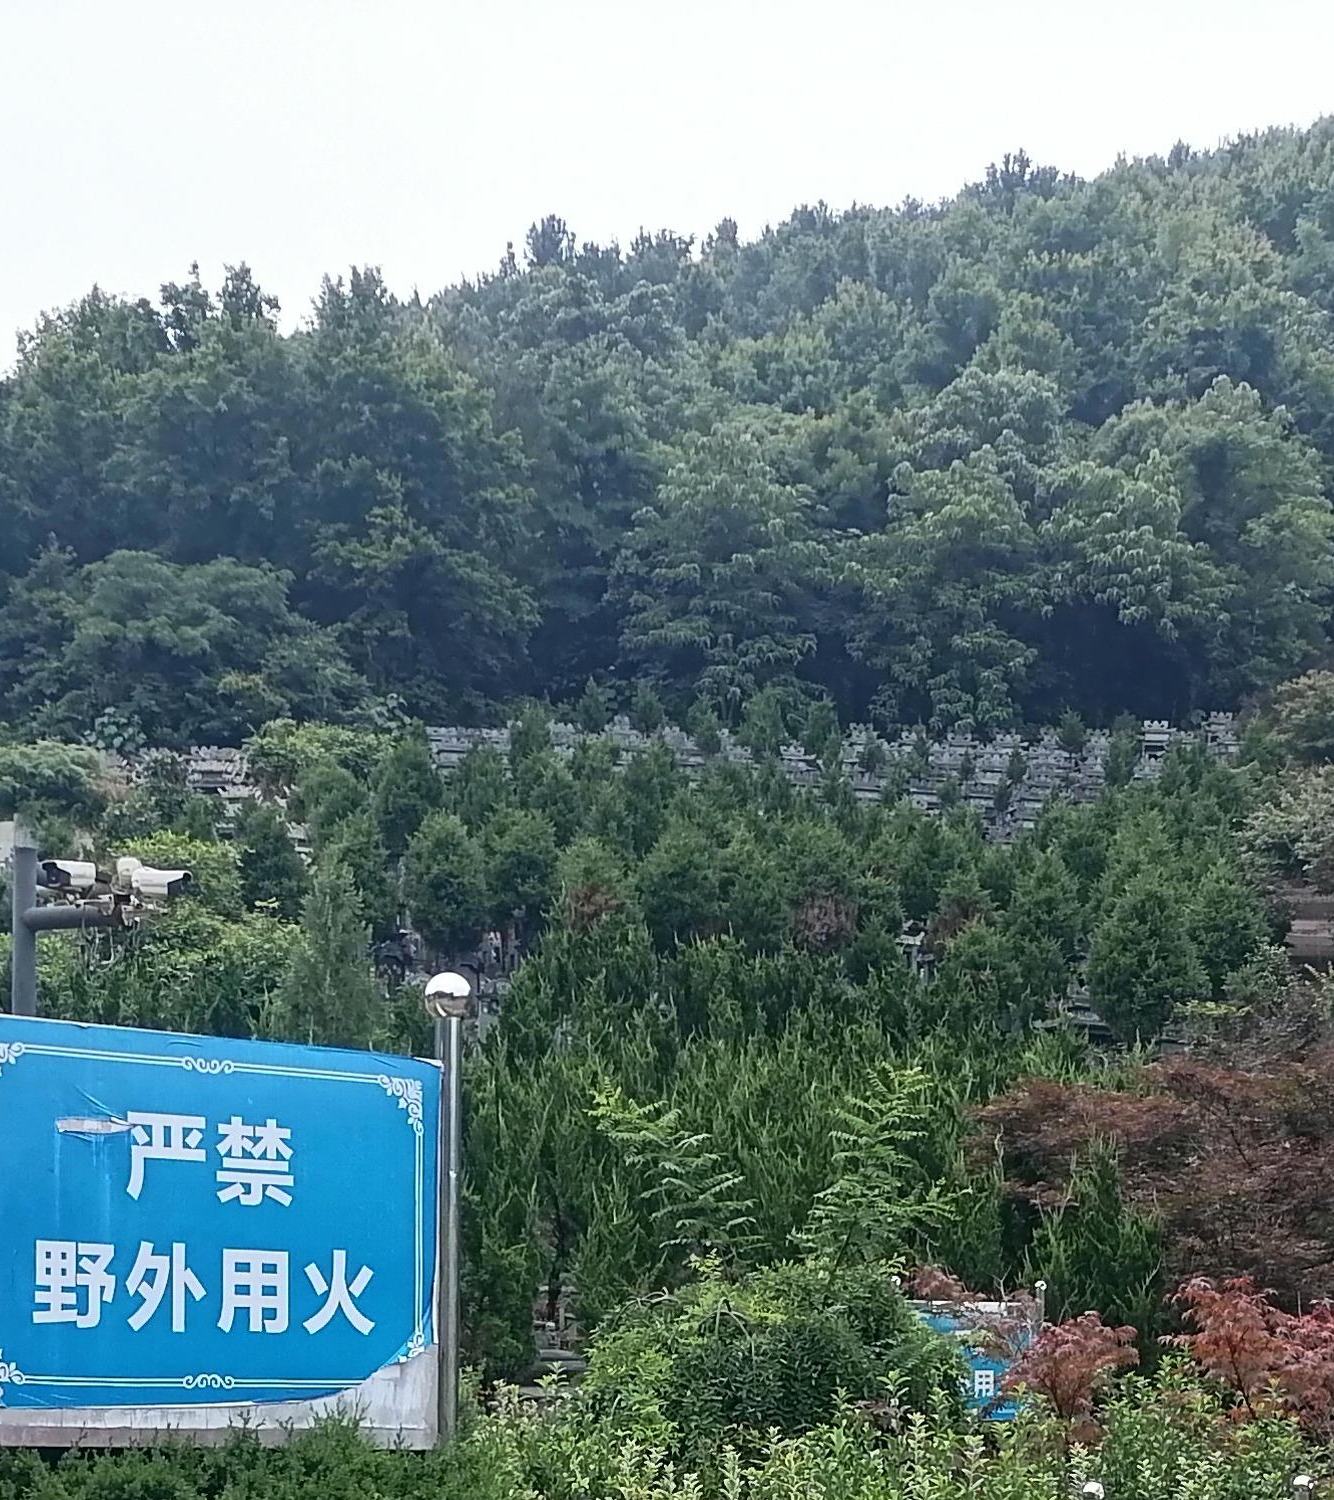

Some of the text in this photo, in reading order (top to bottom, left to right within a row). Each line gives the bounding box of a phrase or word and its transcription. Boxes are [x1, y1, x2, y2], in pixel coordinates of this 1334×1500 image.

[126, 1110, 295, 1208] 严禁
[32, 1238, 375, 1336] 野外用火
